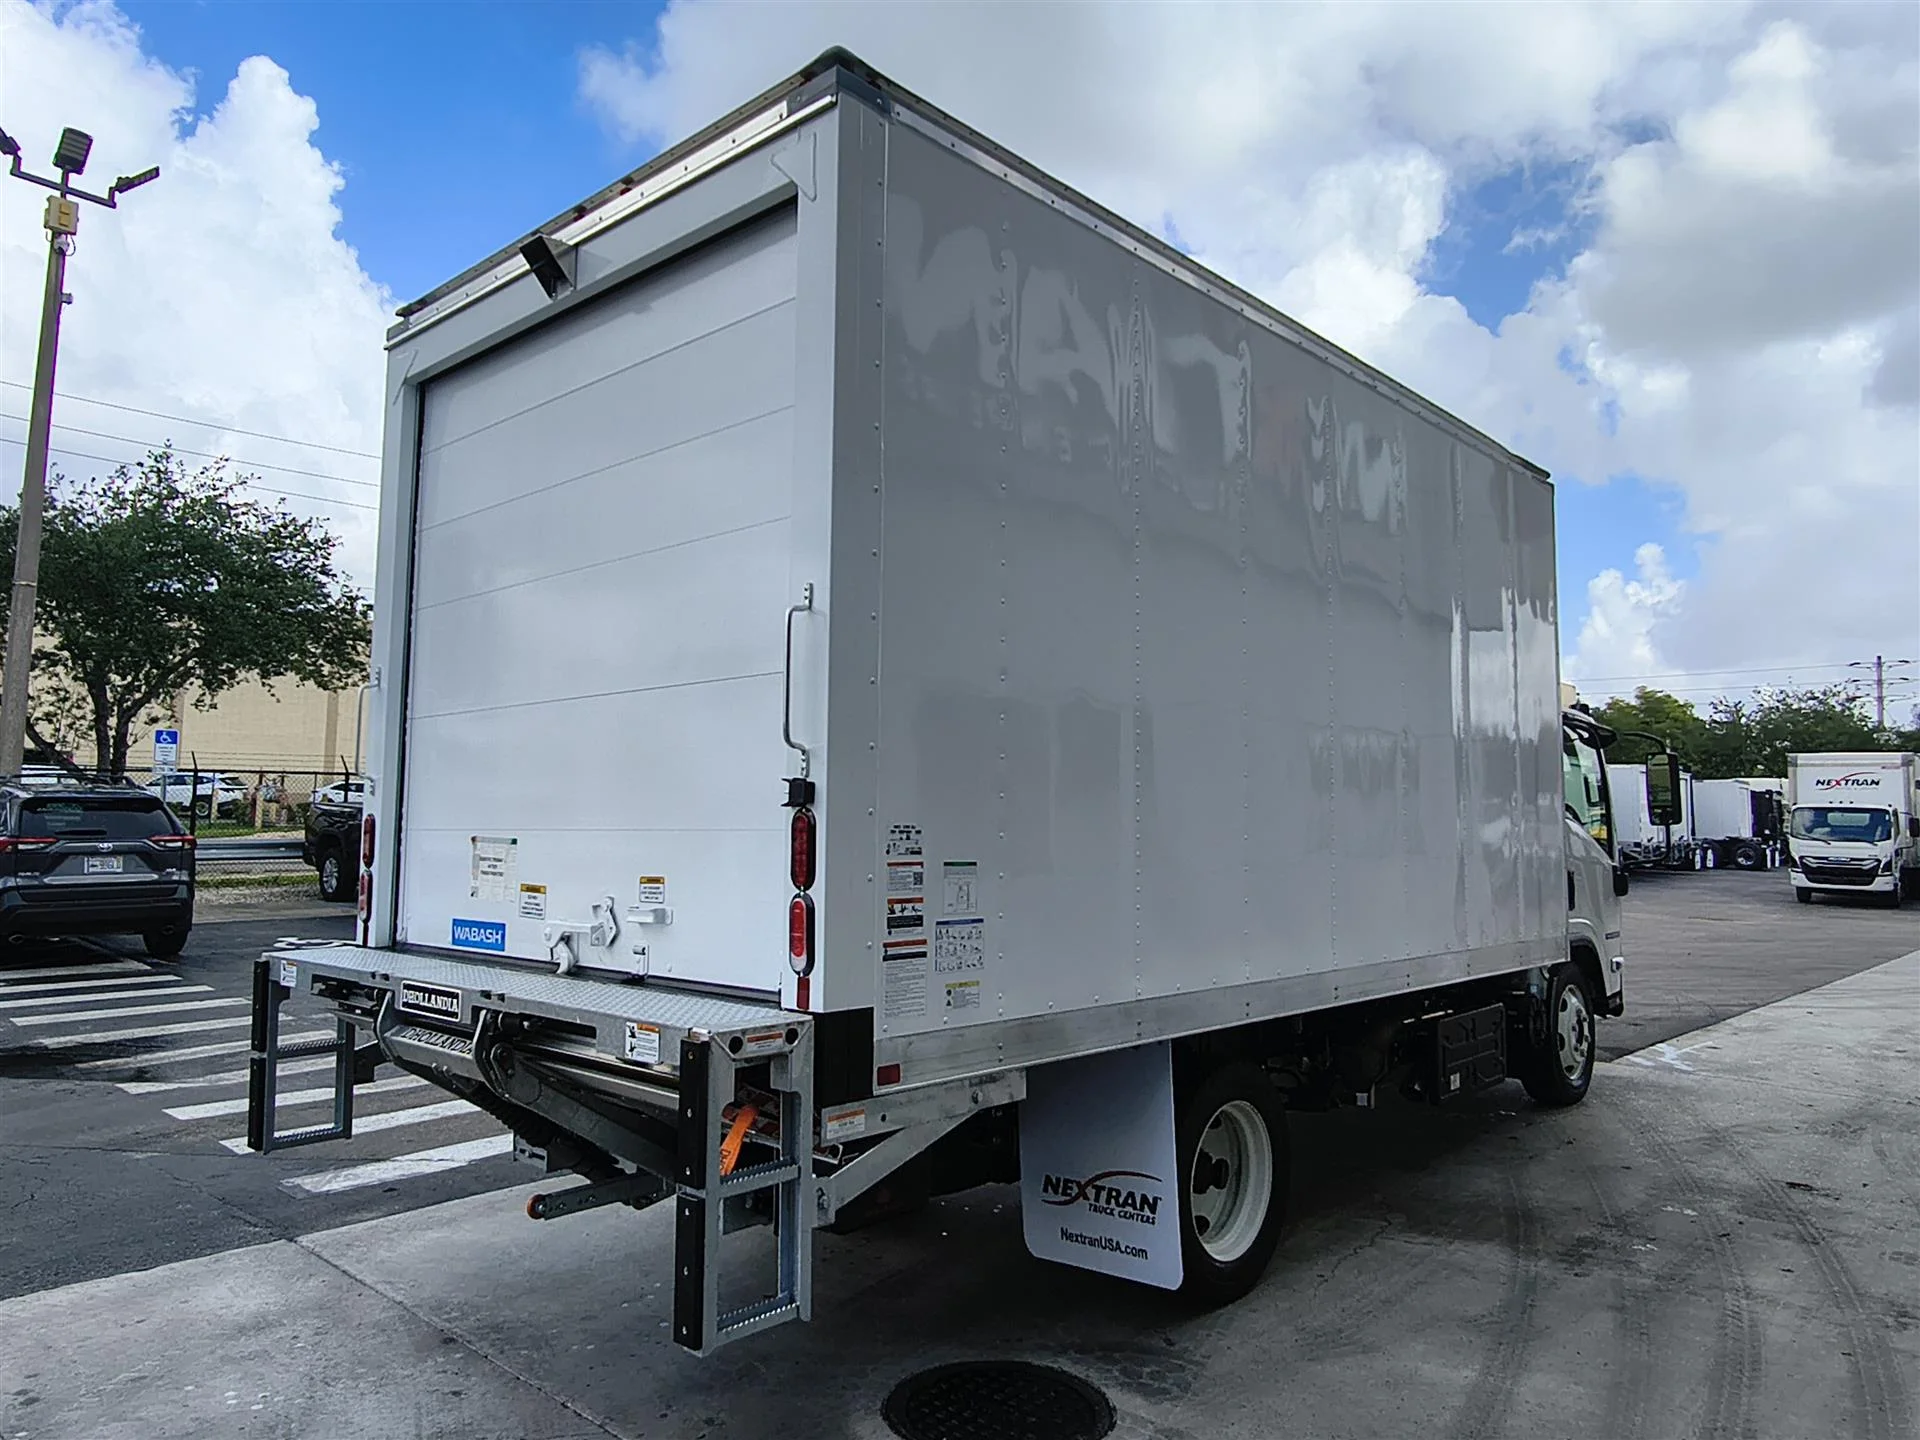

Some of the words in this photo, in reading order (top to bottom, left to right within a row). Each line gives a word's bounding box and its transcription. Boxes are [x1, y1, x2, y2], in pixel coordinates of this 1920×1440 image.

[1815, 777, 1880, 788] NEXTRAN
[454, 926, 502, 943] WABASH
[402, 989, 459, 1012] DHOLLANDIA
[1042, 1173, 1160, 1215] NEXTRAN
[1088, 1202, 1115, 1217] TRUCK
[1117, 1209, 1156, 1226] CENTERS
[1060, 1226, 1148, 1260] NextranUSA.com
